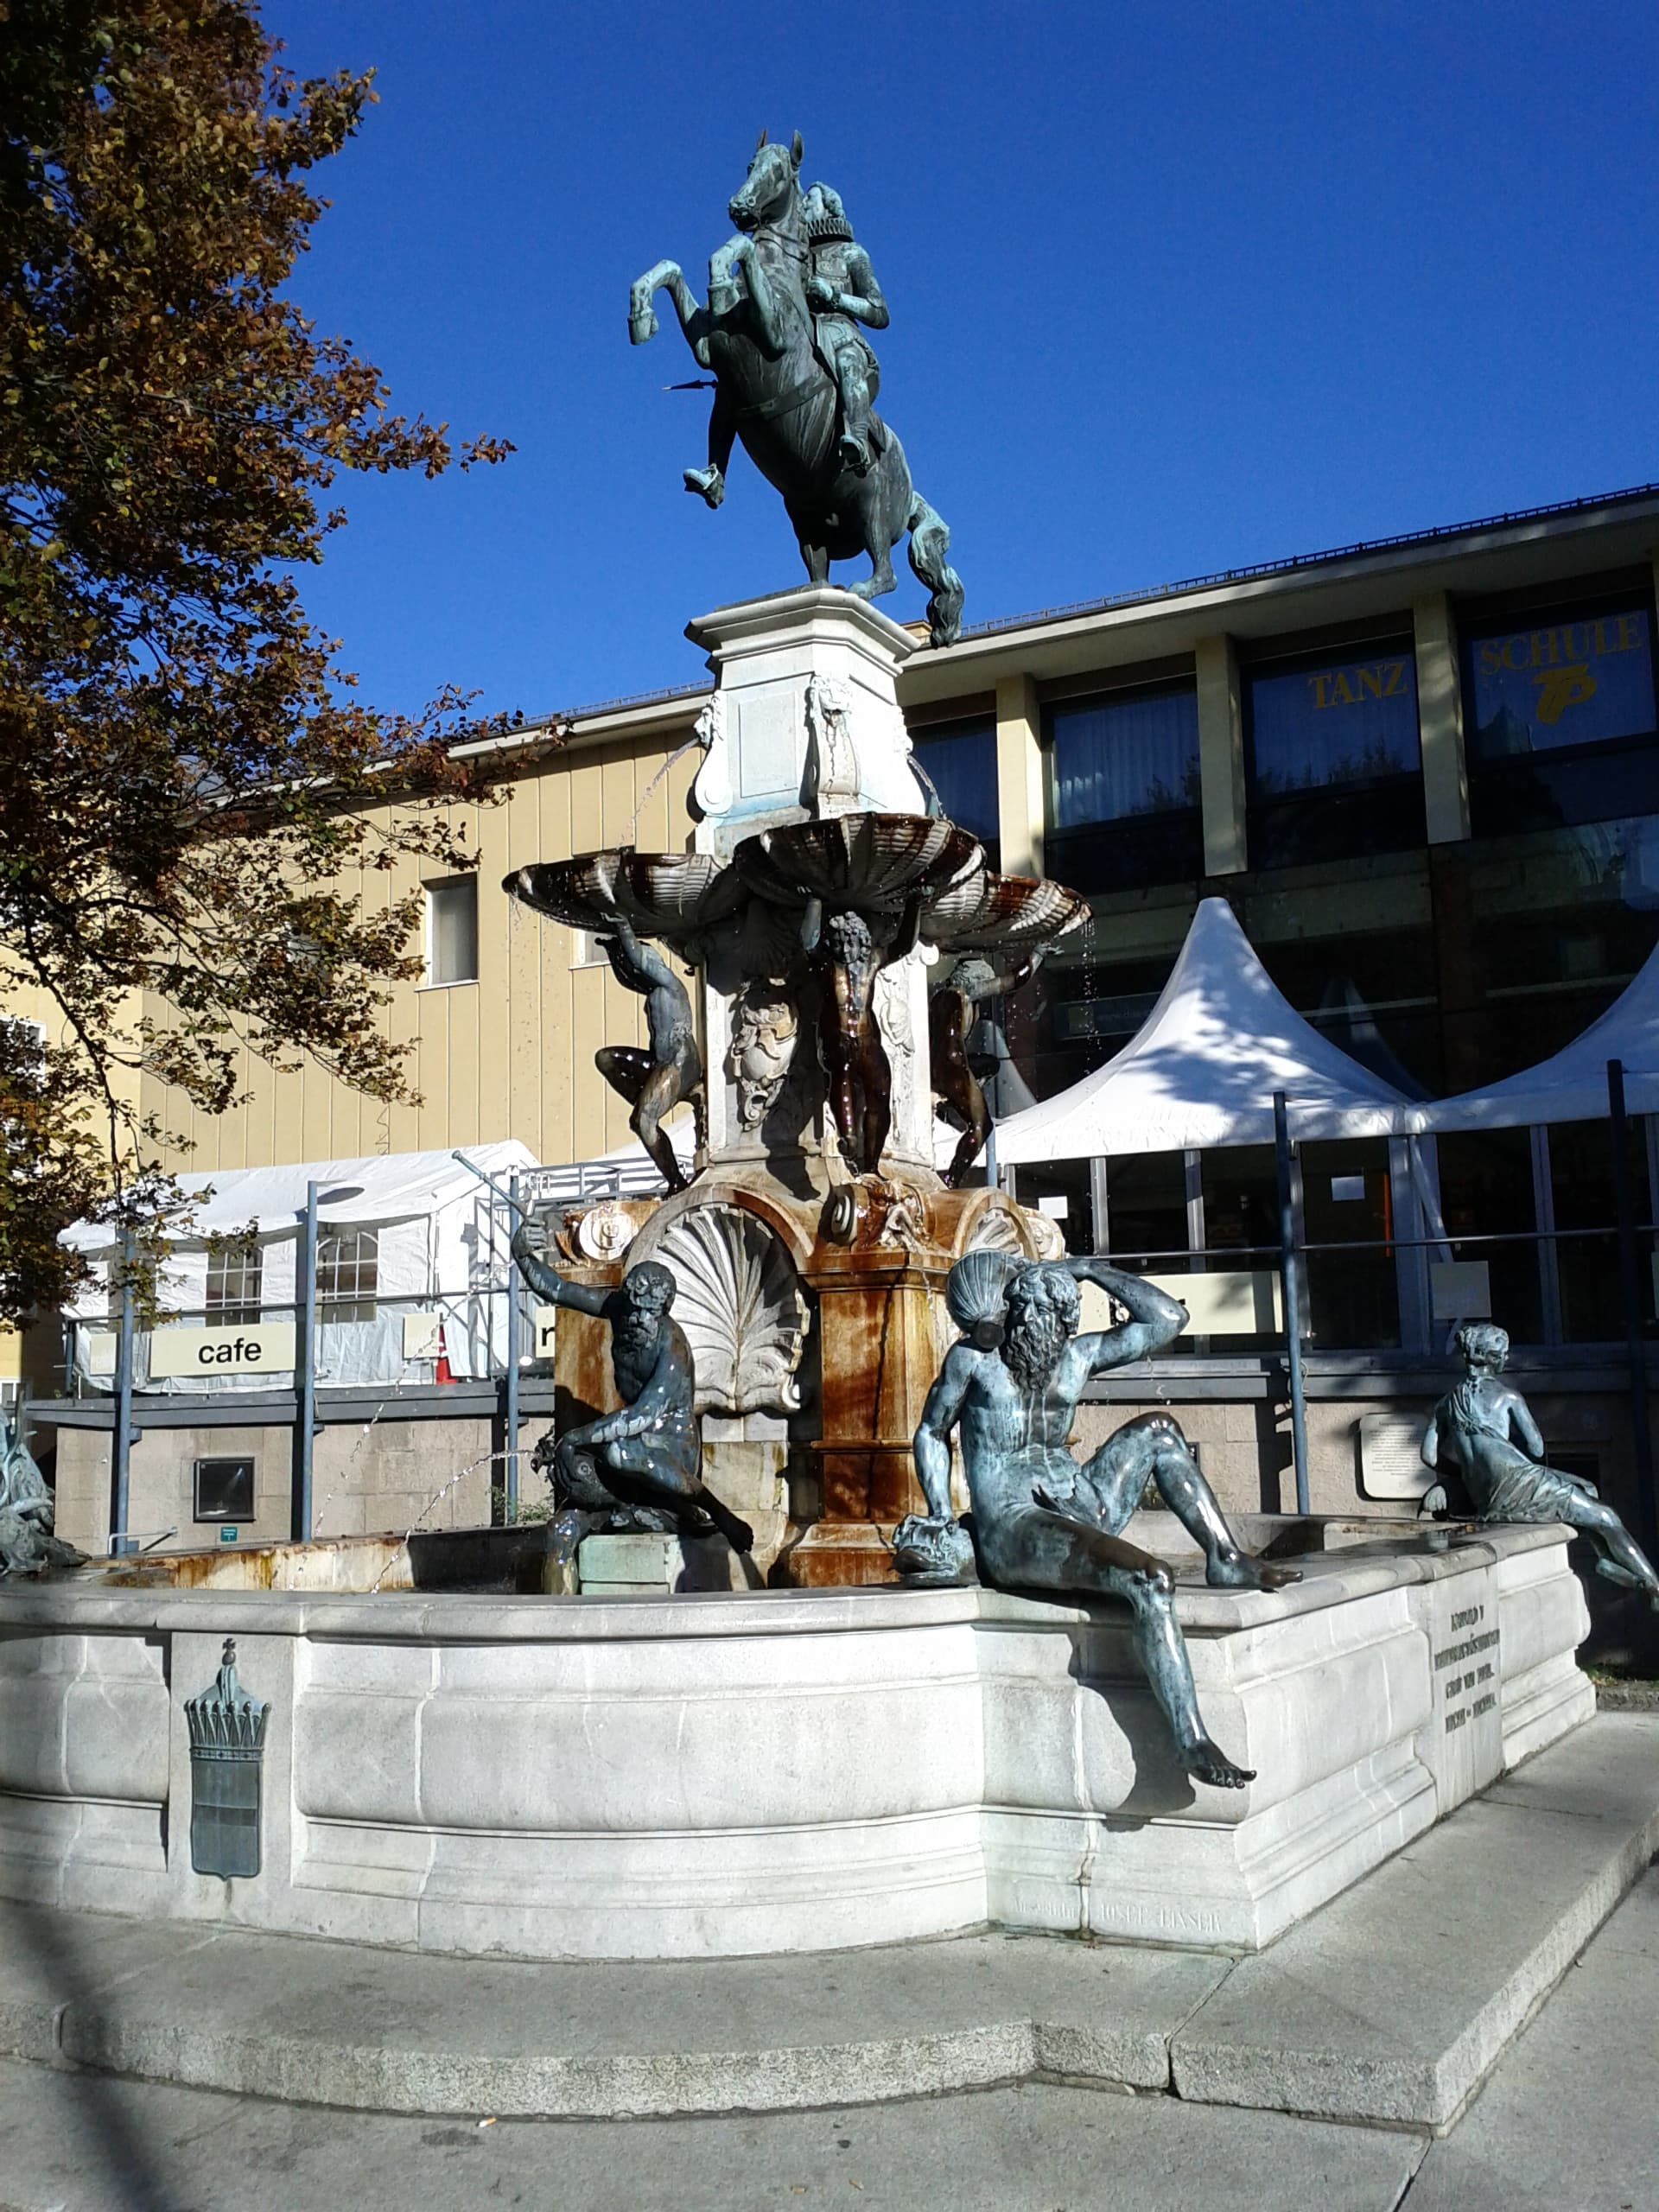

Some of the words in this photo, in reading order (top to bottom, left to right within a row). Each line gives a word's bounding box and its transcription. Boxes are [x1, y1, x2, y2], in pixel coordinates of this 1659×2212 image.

[1480, 615, 1643, 676] SCHULE
[1306, 663, 1408, 709] TANZ
[198, 1337, 262, 1364] cafe
